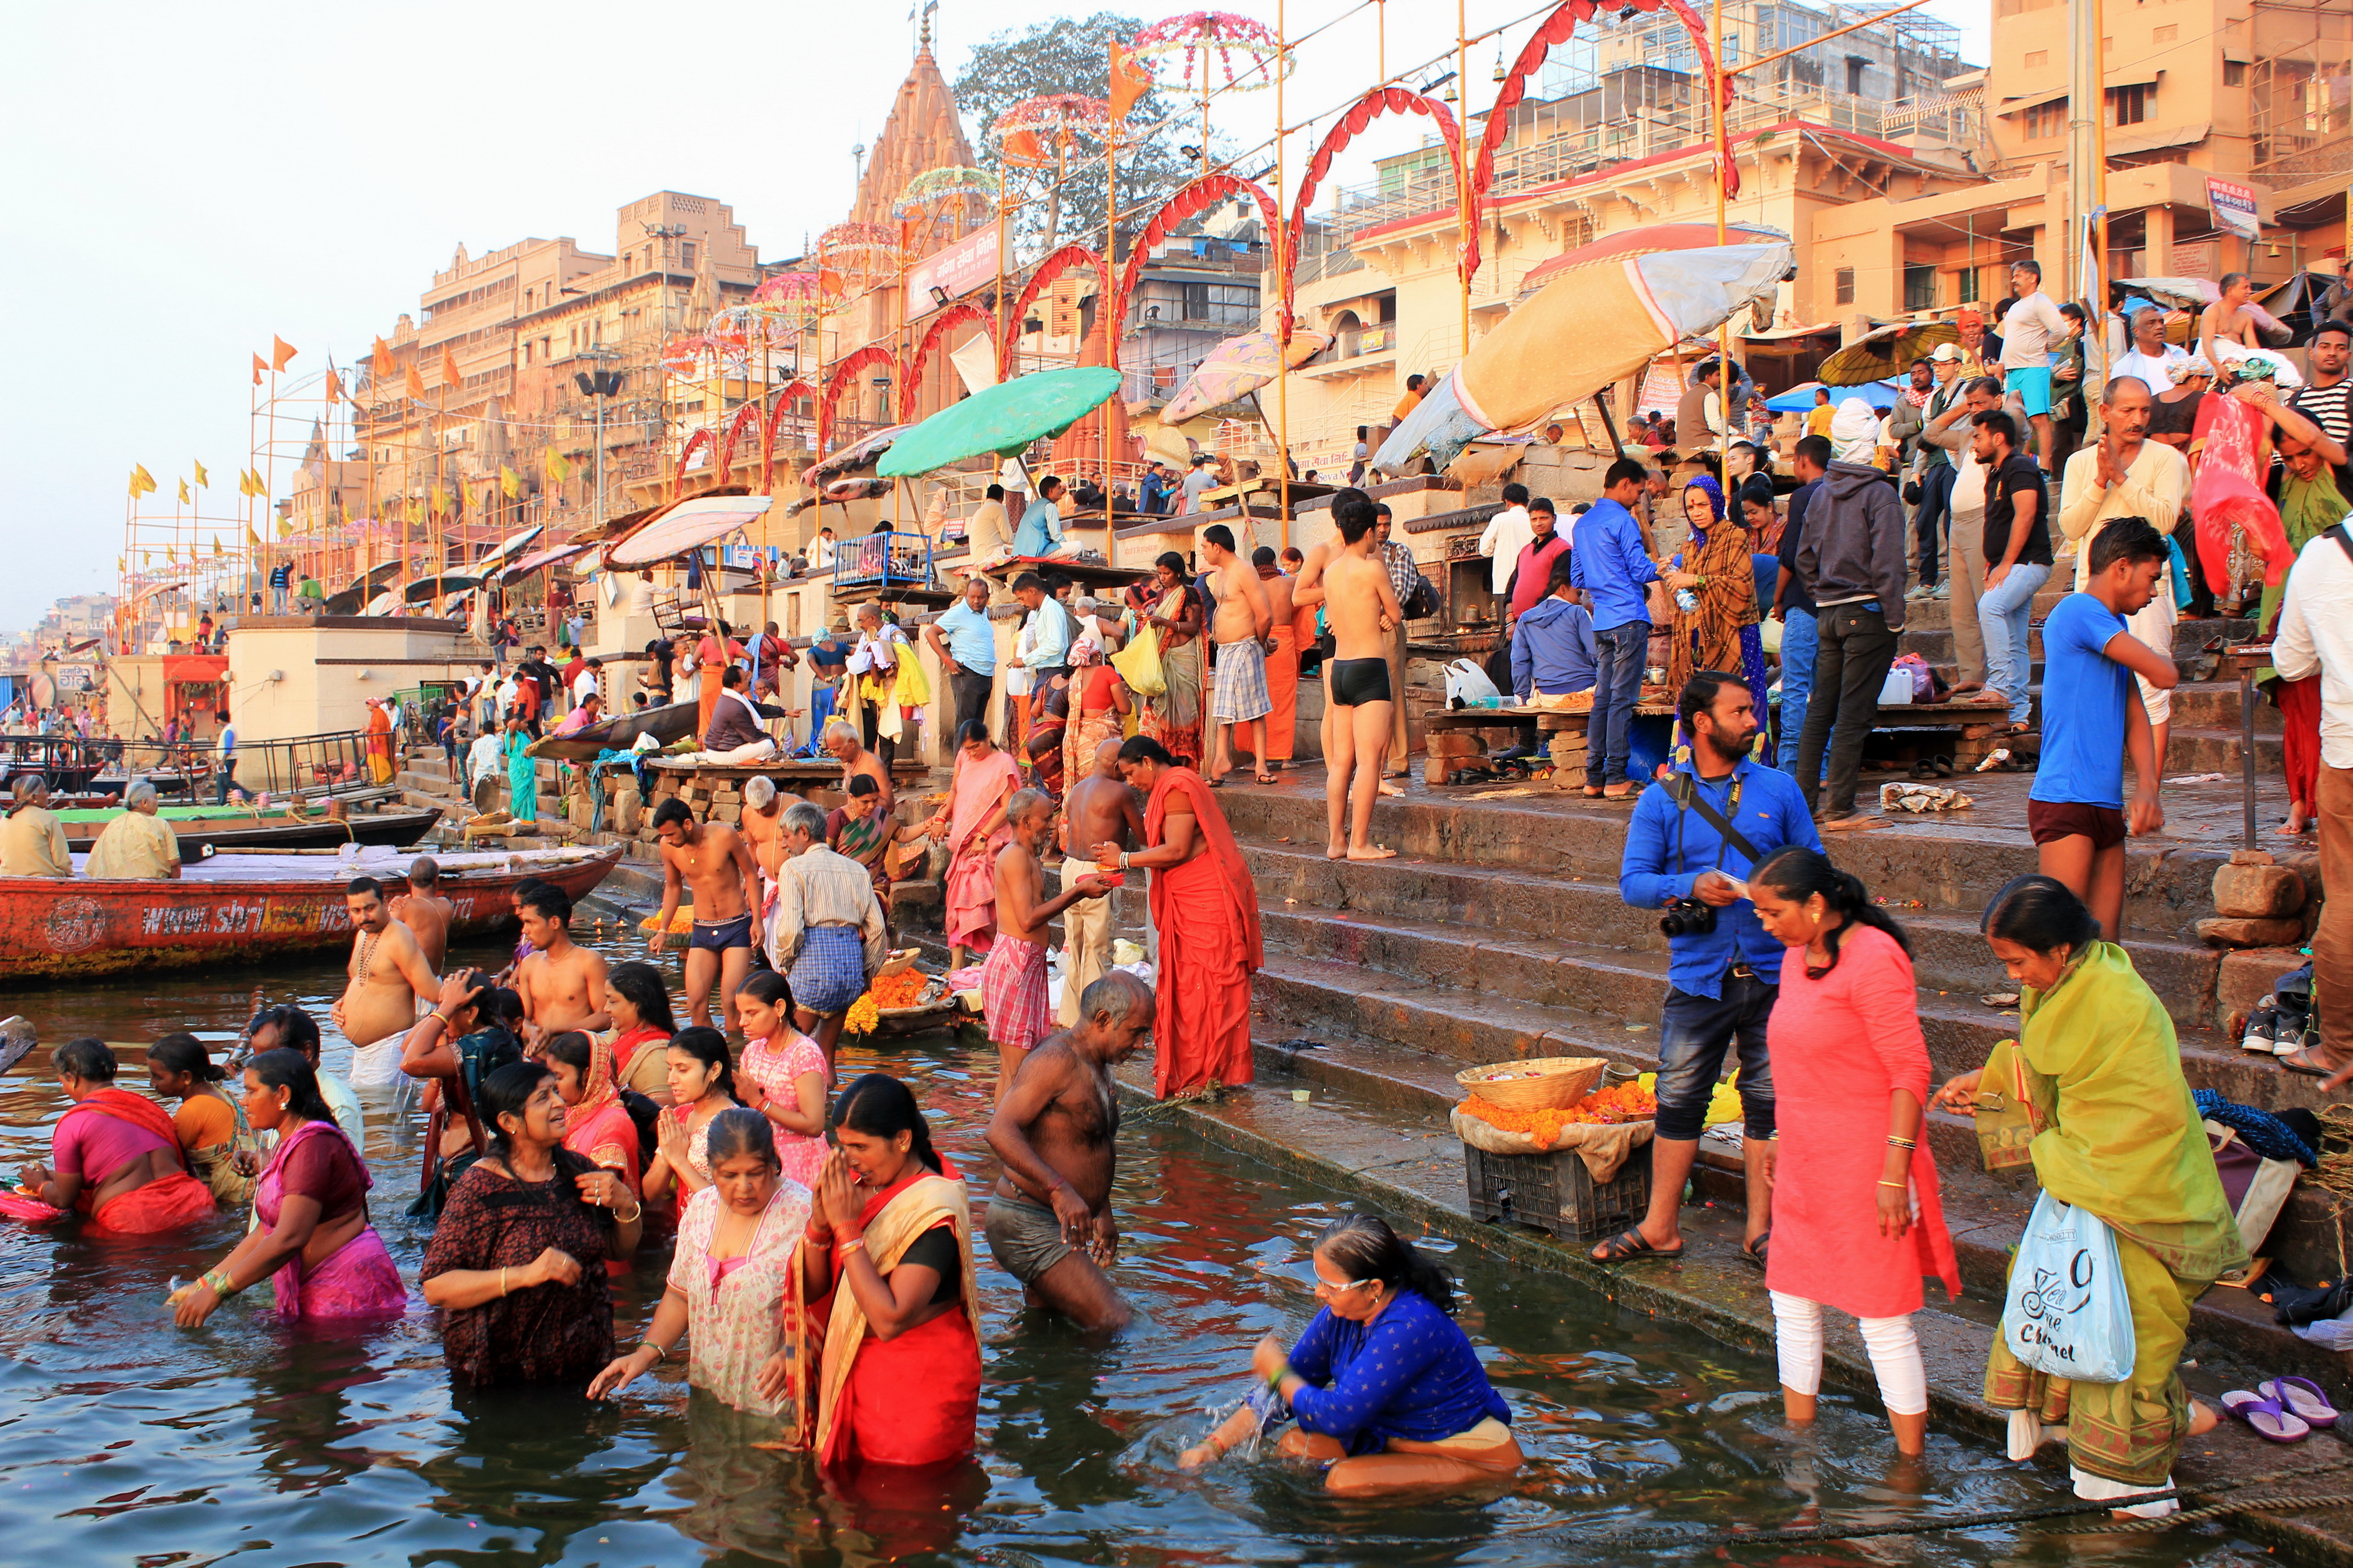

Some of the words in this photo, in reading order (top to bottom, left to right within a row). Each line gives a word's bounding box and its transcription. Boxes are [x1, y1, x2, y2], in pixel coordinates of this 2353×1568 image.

[937, 257, 956, 278] गंगा
[957, 247, 974, 268] सेवा
[976, 231, 998, 259] निधि
[1318, 472, 1338, 483] Seva
[2050, 1231, 2076, 1243] NOVELTY
